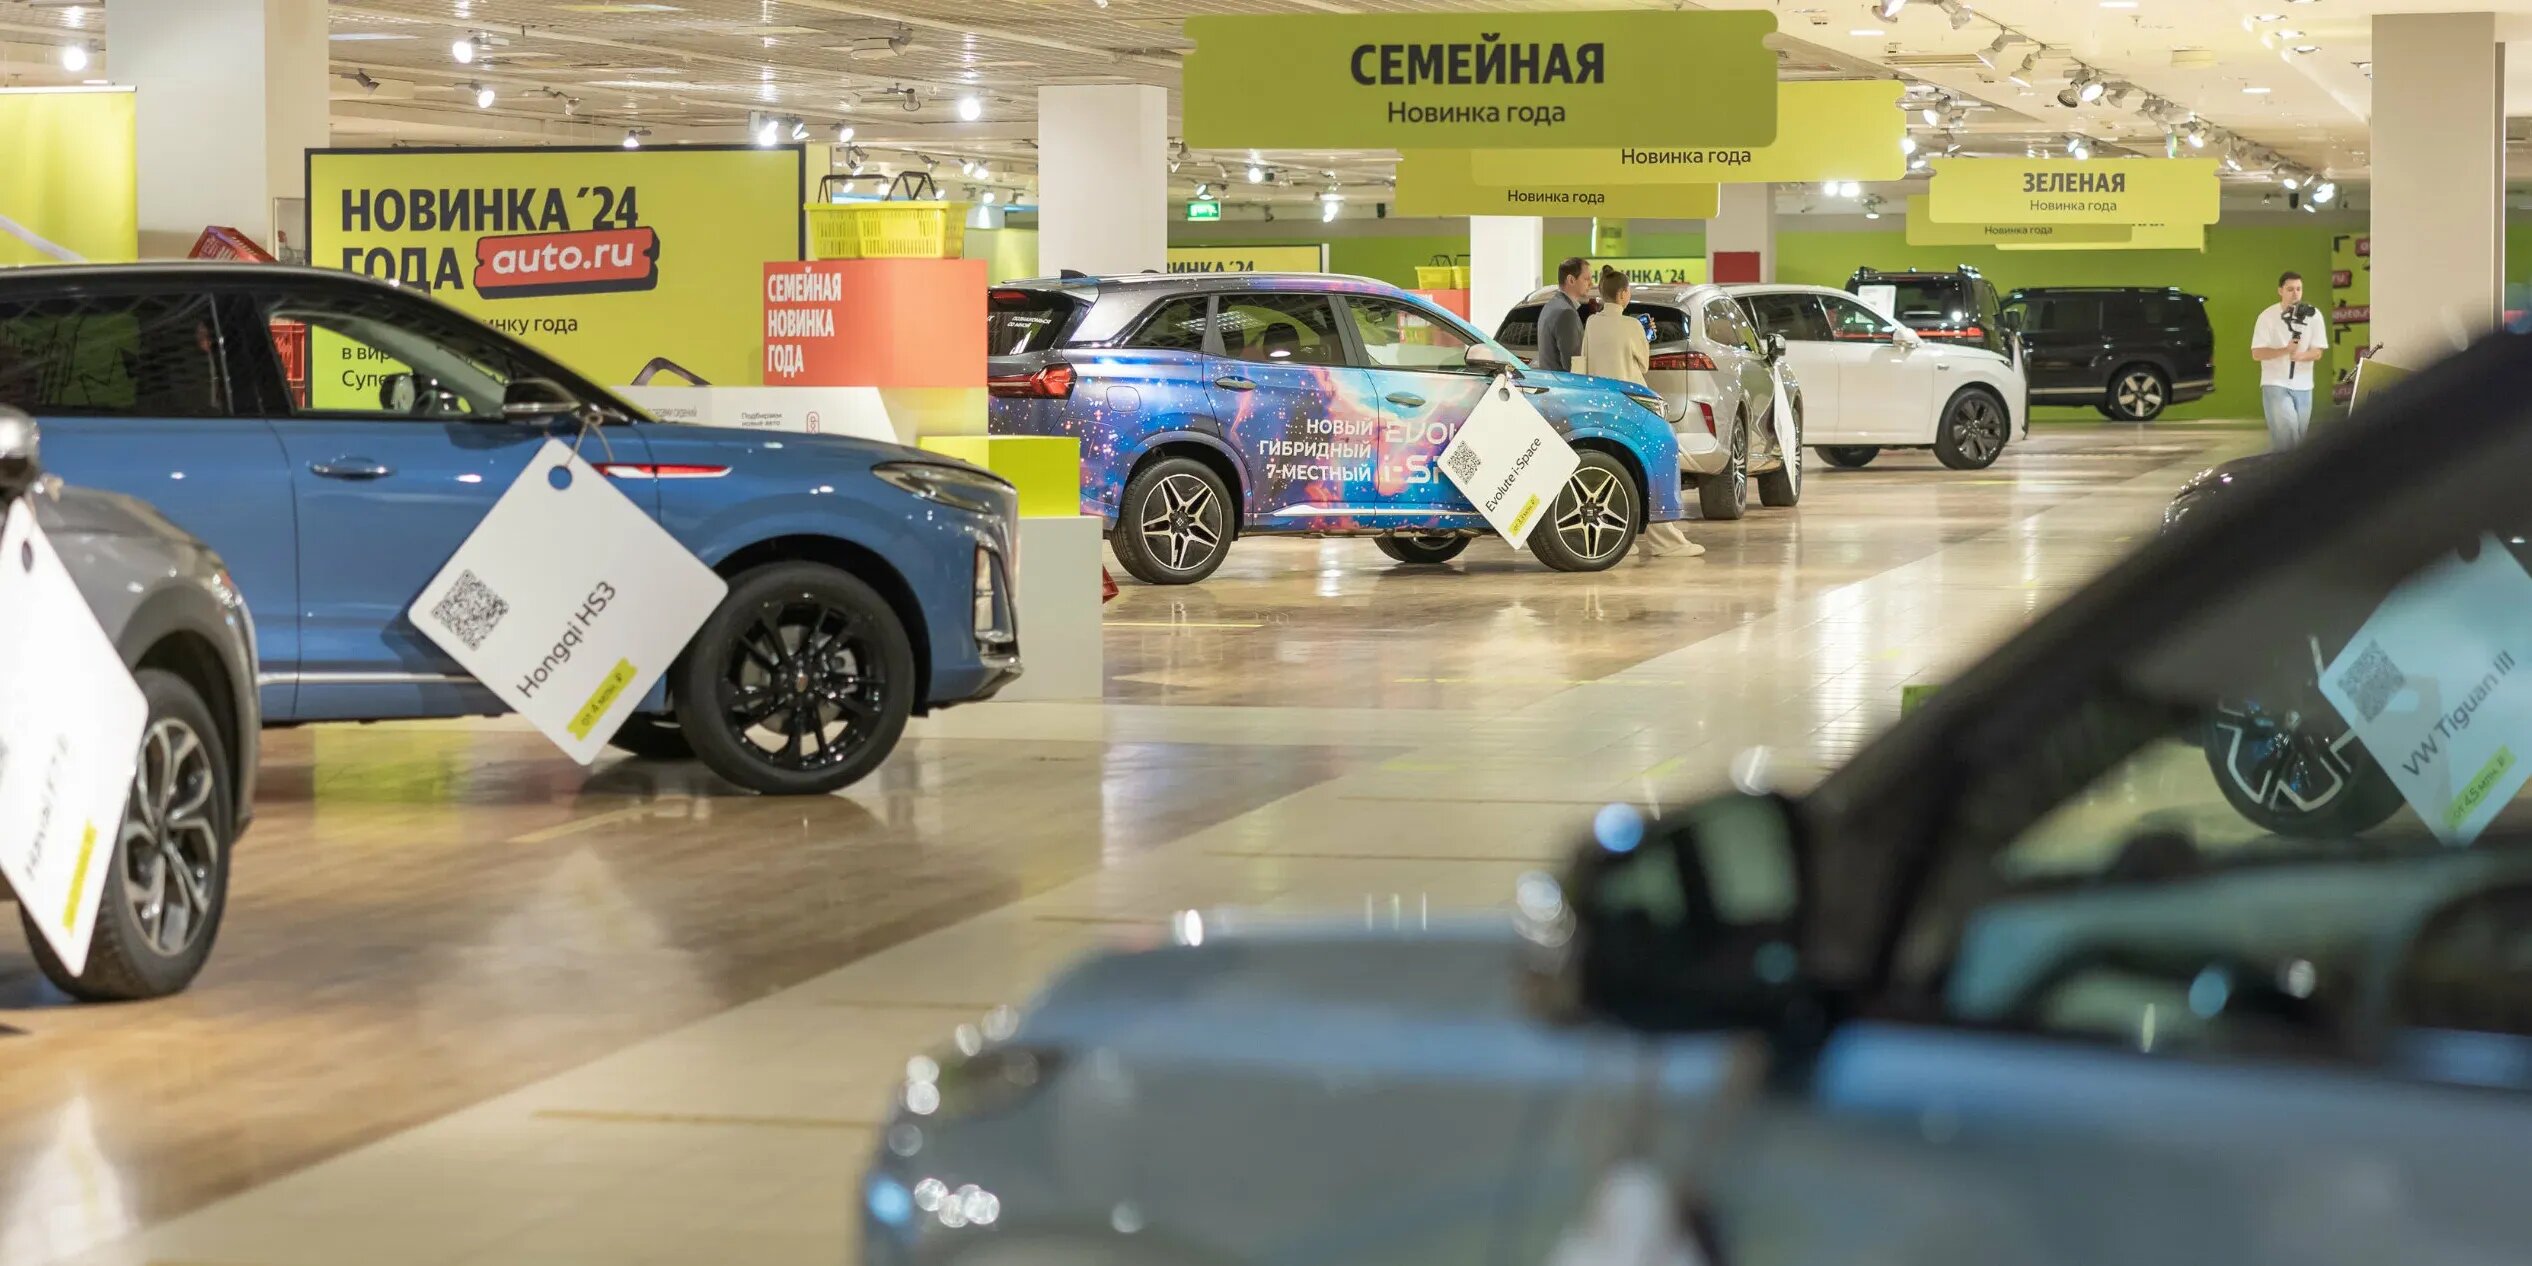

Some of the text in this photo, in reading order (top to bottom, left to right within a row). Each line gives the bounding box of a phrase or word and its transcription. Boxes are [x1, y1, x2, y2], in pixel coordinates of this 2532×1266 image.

[1350, 33, 1605, 86] СЕМЕЙНАЯ
[1388, 102, 1566, 126] Новинка года
[1621, 149, 1751, 165] Новинка года
[2023, 173, 2126, 192] ЗЕЛЕНАЯ
[1507, 190, 1605, 204] Новинка года
[2030, 200, 2117, 213] Новинка года
[341, 187, 571, 232] НОВИНКА
[1984, 226, 2053, 236] Новинка года
[492, 242, 635, 274] auto.ru
[768, 266, 842, 302] СЕМЕЙНАЯ
[533, 318, 578, 334] года
[767, 309, 835, 337] НОВИНКА
[342, 347, 351, 359] в
[767, 344, 805, 378] ГОДА
[1306, 418, 1373, 436] НОВЫЙ
[1259, 440, 1371, 459] ГИБРИДНЫЙ
[1266, 462, 1371, 482] 7-МЕСТНЫЙ
[1485, 437, 1542, 512] Evolute i-Space
[516, 580, 616, 698] Hongqi HS3
[2402, 650, 2517, 776] VW Tiguan III
